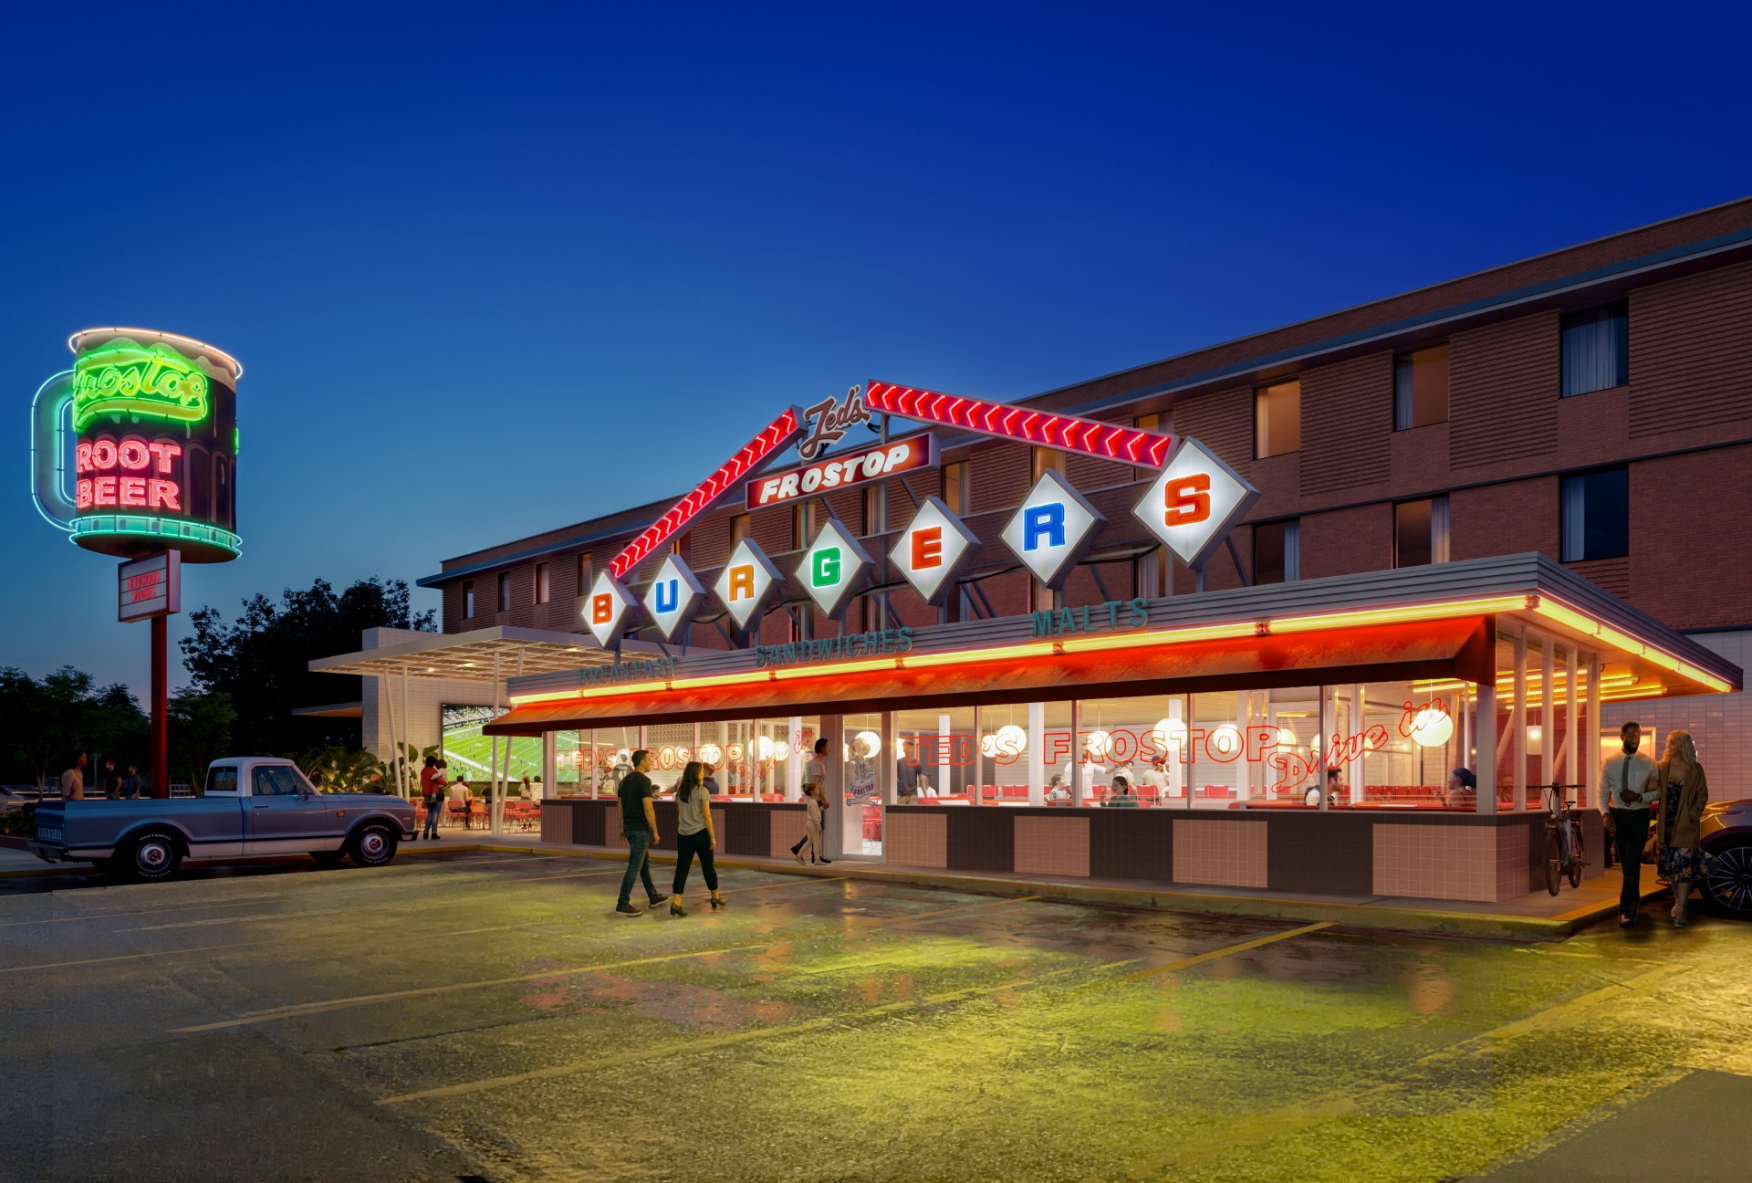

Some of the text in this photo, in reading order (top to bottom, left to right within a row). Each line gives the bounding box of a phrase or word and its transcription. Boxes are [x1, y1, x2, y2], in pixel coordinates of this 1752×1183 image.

[76, 440, 181, 473] ROOT
[759, 444, 910, 504] FROSTOP
[76, 477, 181, 510] BEER
[1032, 597, 1148, 637] MALTS
[756, 627, 913, 667] SANDWICHES
[578, 656, 679, 687] BREAKFAST
[556, 748, 618, 772] TED'S
[902, 726, 1281, 766] TED'S FROSTOP
[1267, 725, 1389, 793] Drive
